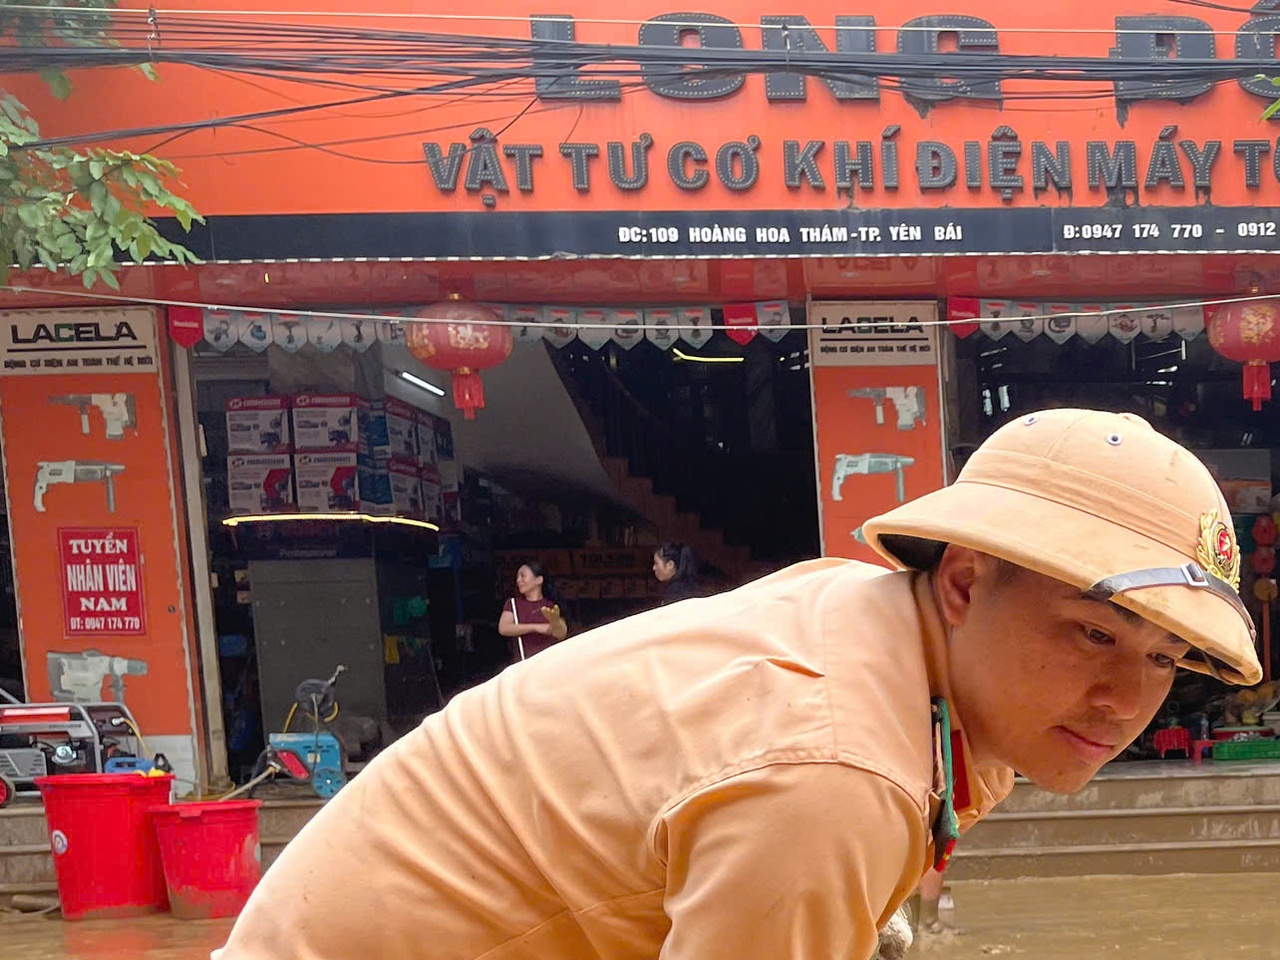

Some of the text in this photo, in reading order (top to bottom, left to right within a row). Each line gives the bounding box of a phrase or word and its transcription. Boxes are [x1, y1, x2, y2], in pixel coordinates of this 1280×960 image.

[530, 12, 1004, 103] LONG
[423, 128, 543, 207] VẬT
[559, 132, 653, 191] TƯ
[667, 135, 761, 191] CƠ
[783, 125, 901, 191] KHÍ
[915, 125, 1071, 200] ĐIỆN
[1086, 125, 1221, 191] MÁY
[689, 223, 747, 243] HOÀNG
[756, 227, 791, 243] HOA
[800, 223, 848, 243] THÁM
[889, 222, 922, 241] YÊN
[934, 222, 963, 241] BÁI
[1132, 223, 1160, 238] 174
[1170, 223, 1203, 238] 770
[1237, 222, 1277, 236] 0912
[11, 321, 138, 344] LACELA
[821, 316, 924, 334] LACELA
[67, 558, 137, 592] NHÂN VIÊN
[80, 597, 128, 612] NAM
[107, 616, 122, 630] 174
[124, 616, 140, 630] 770
